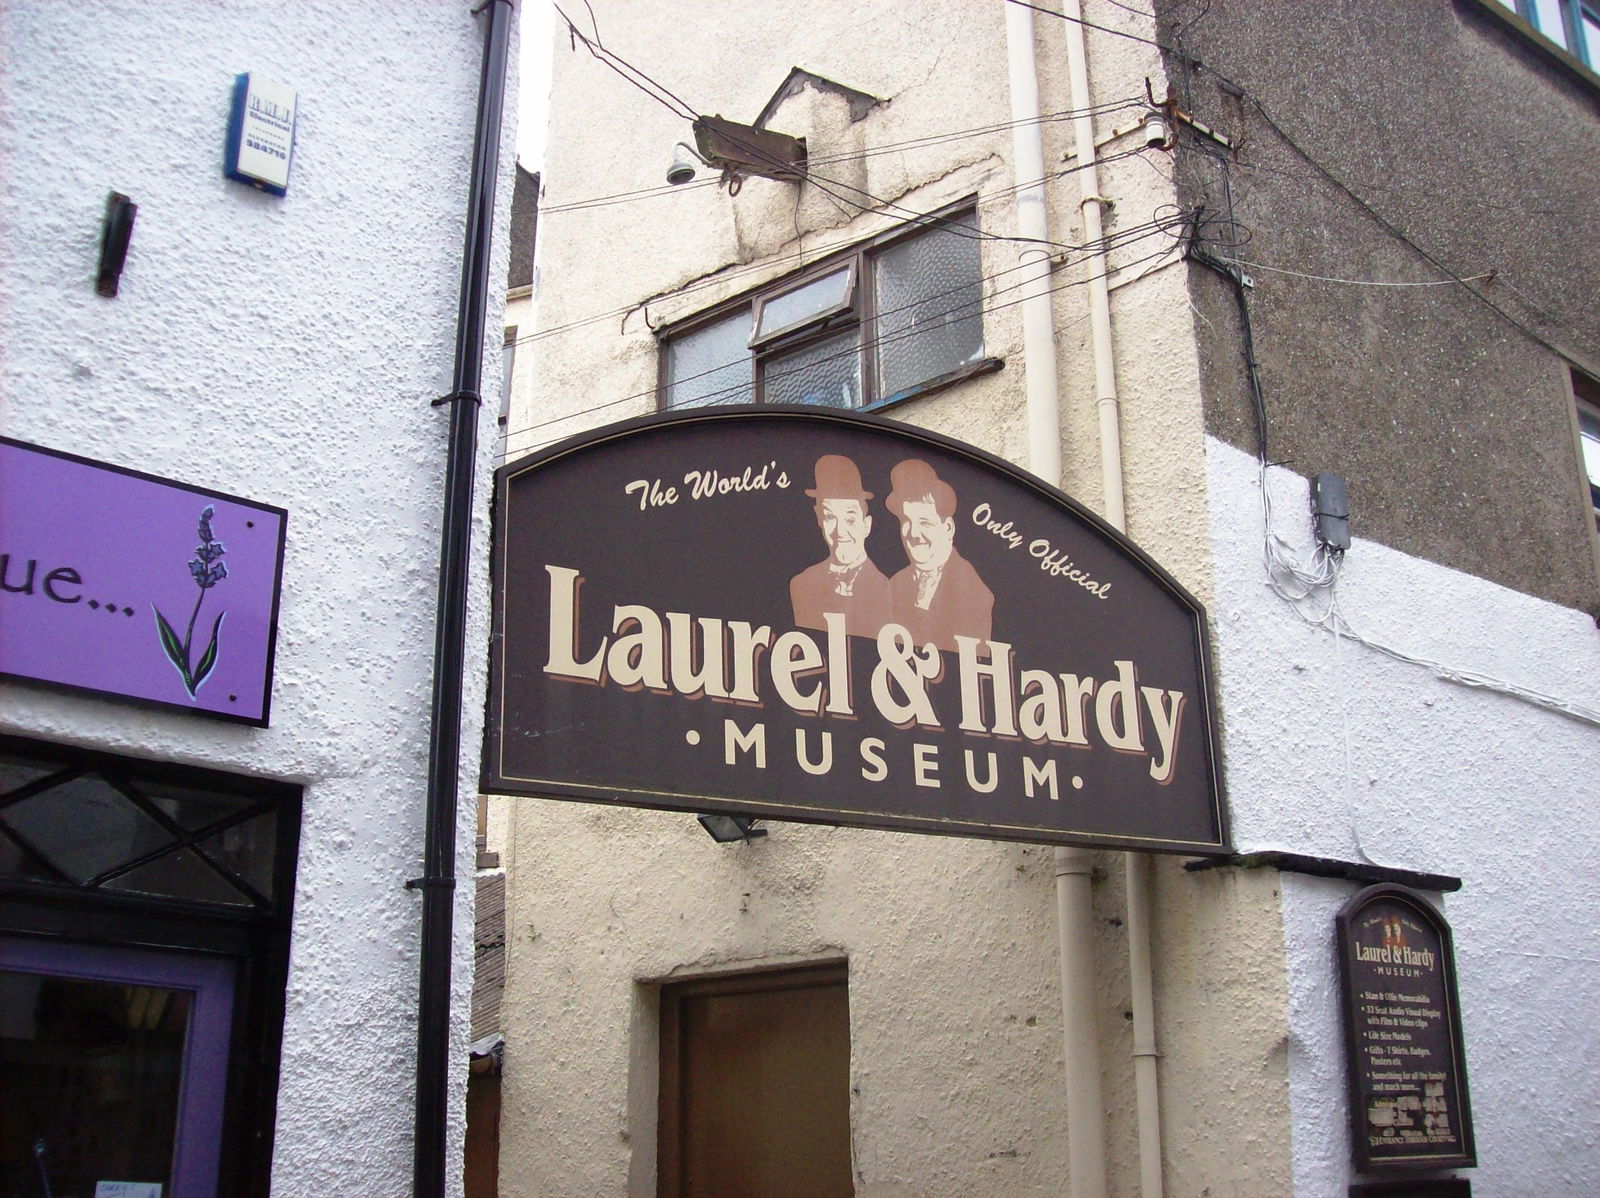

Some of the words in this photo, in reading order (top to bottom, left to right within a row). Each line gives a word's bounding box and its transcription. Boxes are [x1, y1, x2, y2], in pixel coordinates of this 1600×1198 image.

[249, 111, 290, 135] Electrical
[625, 479, 679, 512] The
[684, 460, 791, 500] World's
[973, 502, 1024, 549] Only
[1029, 539, 1111, 600] Official
[543, 564, 855, 718] Laurel
[870, 623, 941, 726] &
[955, 635, 1185, 784] Hardy
[725, 720, 1059, 801] MUSEUM
[1355, 941, 1392, 963] Laurel
[1393, 946, 1402, 964] &
[1402, 945, 1435, 971] Hardy
[1378, 966, 1420, 978] MUSEUM
